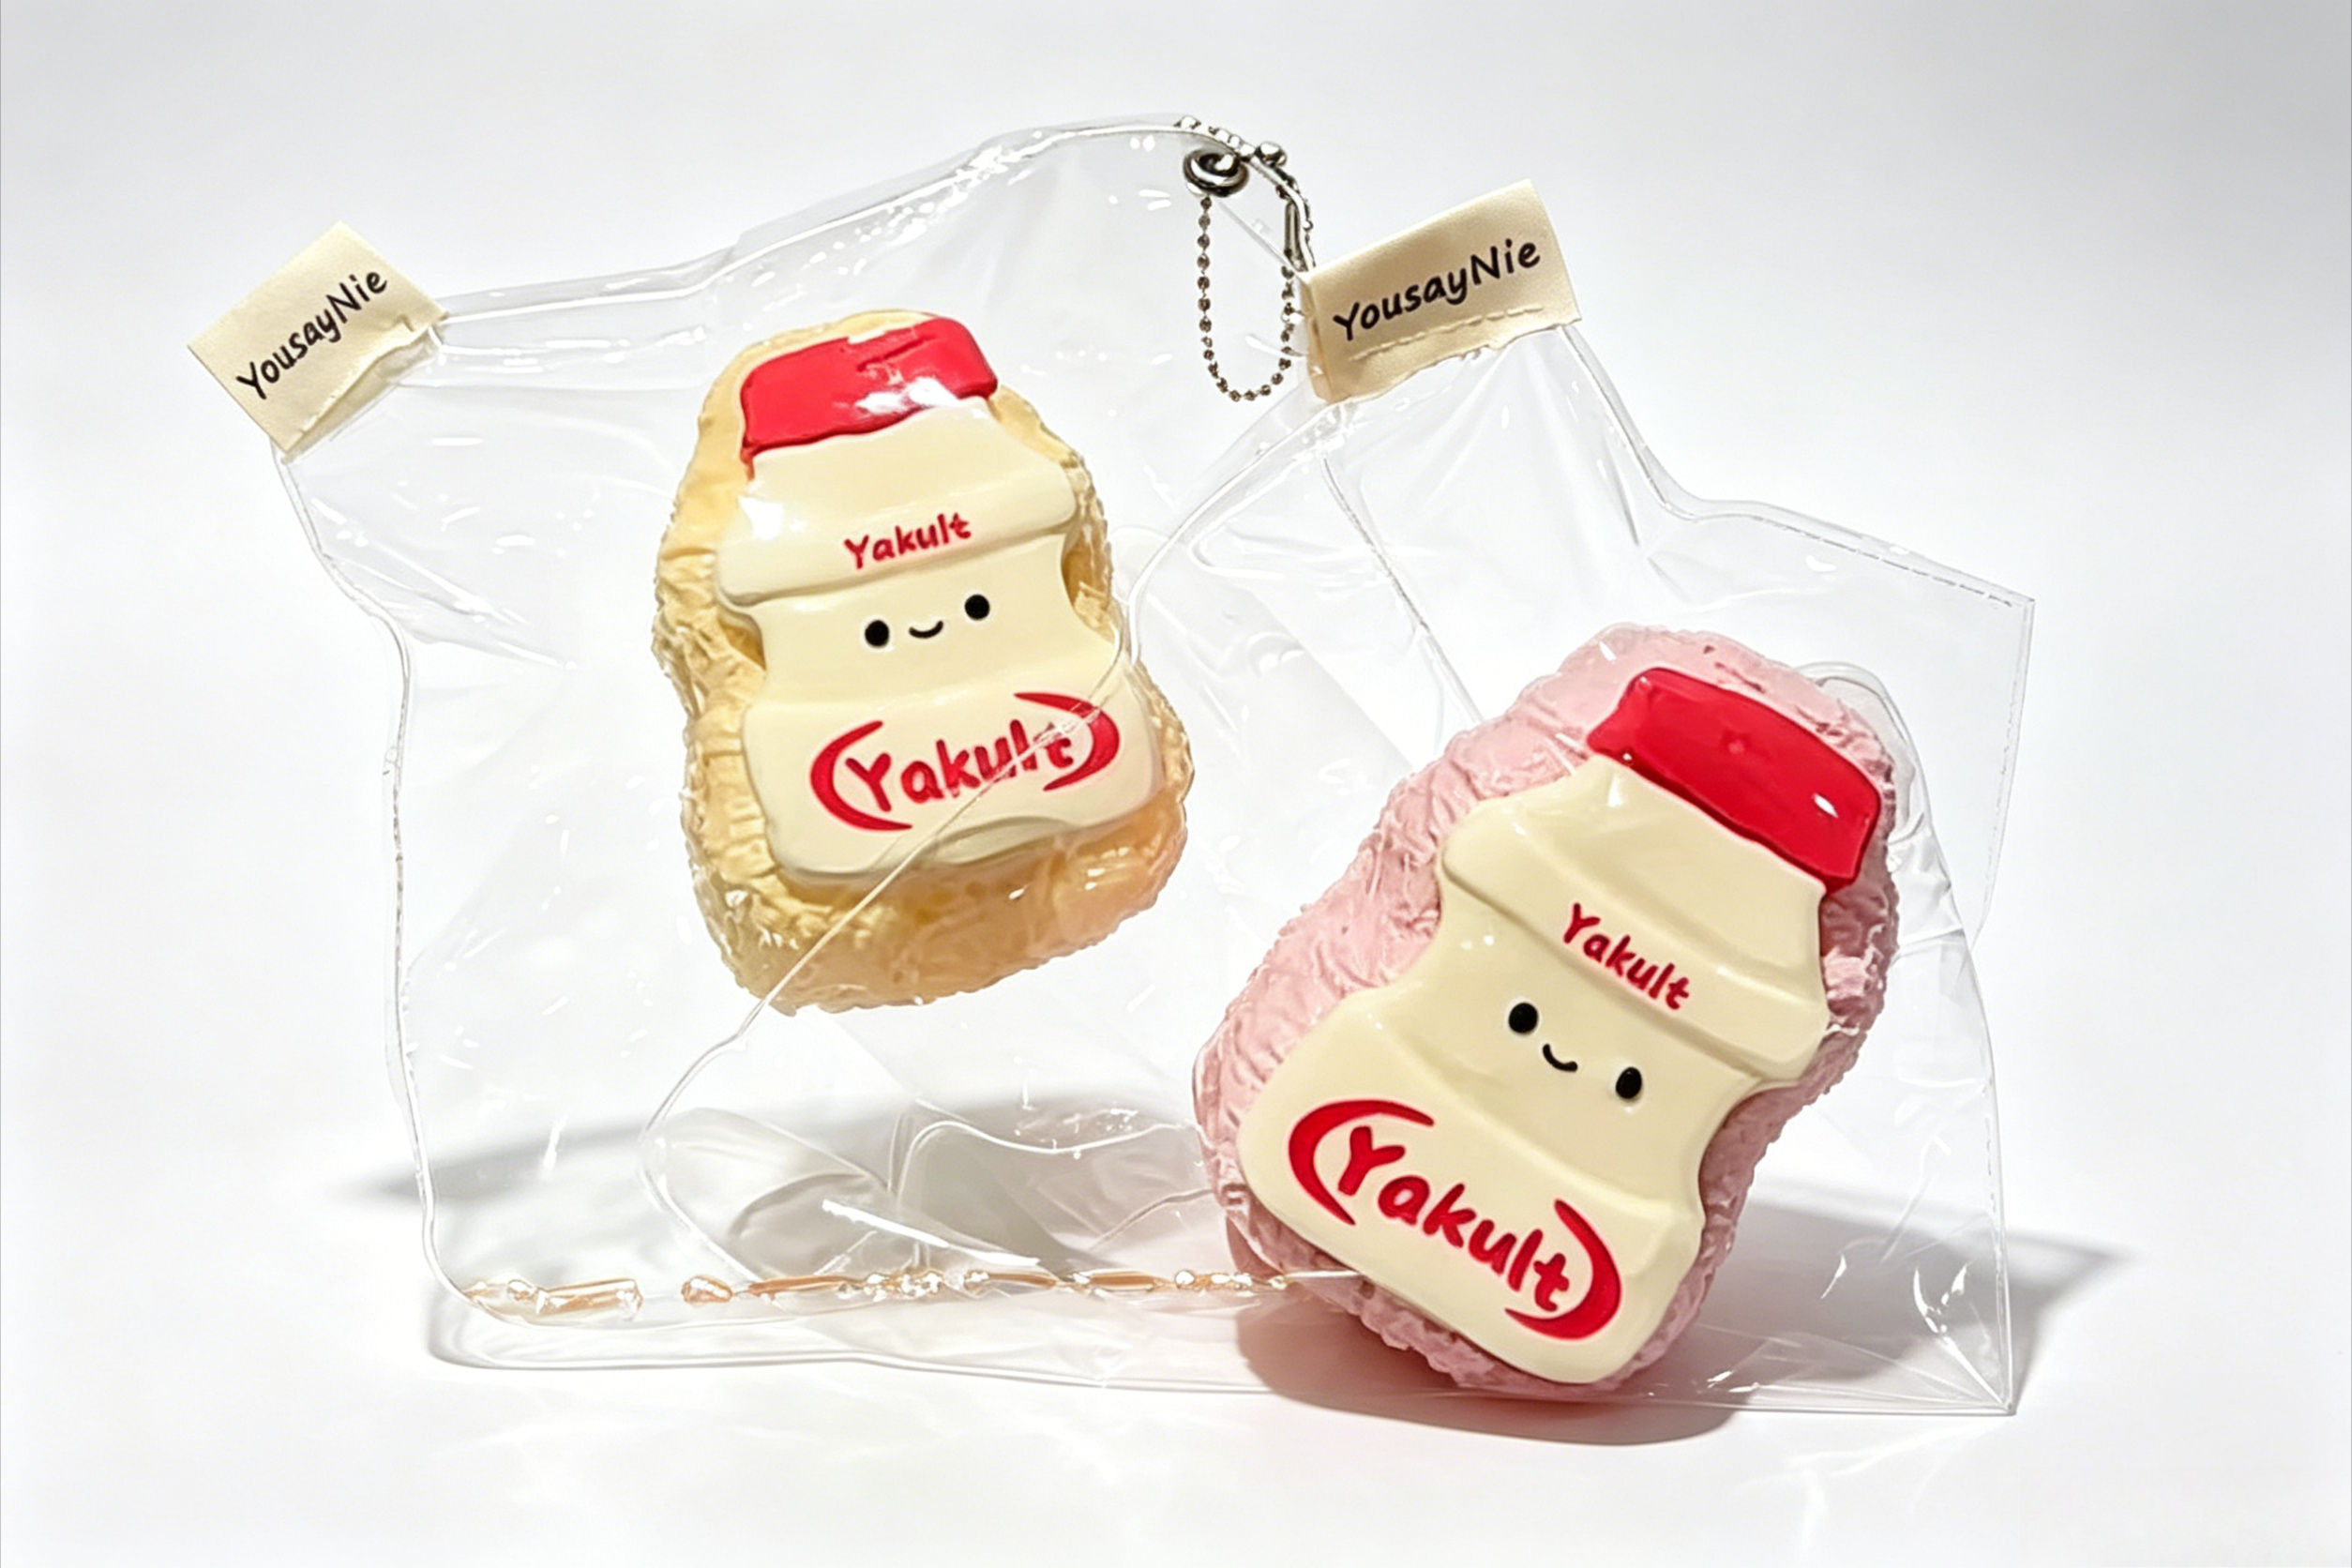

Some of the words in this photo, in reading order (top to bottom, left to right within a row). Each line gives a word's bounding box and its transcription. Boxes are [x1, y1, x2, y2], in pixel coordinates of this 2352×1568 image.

[234, 270, 388, 400] YousayNie
[1332, 237, 1542, 341] YousayNie
[842, 512, 972, 570] Yakult
[843, 717, 1076, 813] Yakult
[1561, 901, 1691, 1012] Yakult
[1335, 1123, 1571, 1314] Yakult
